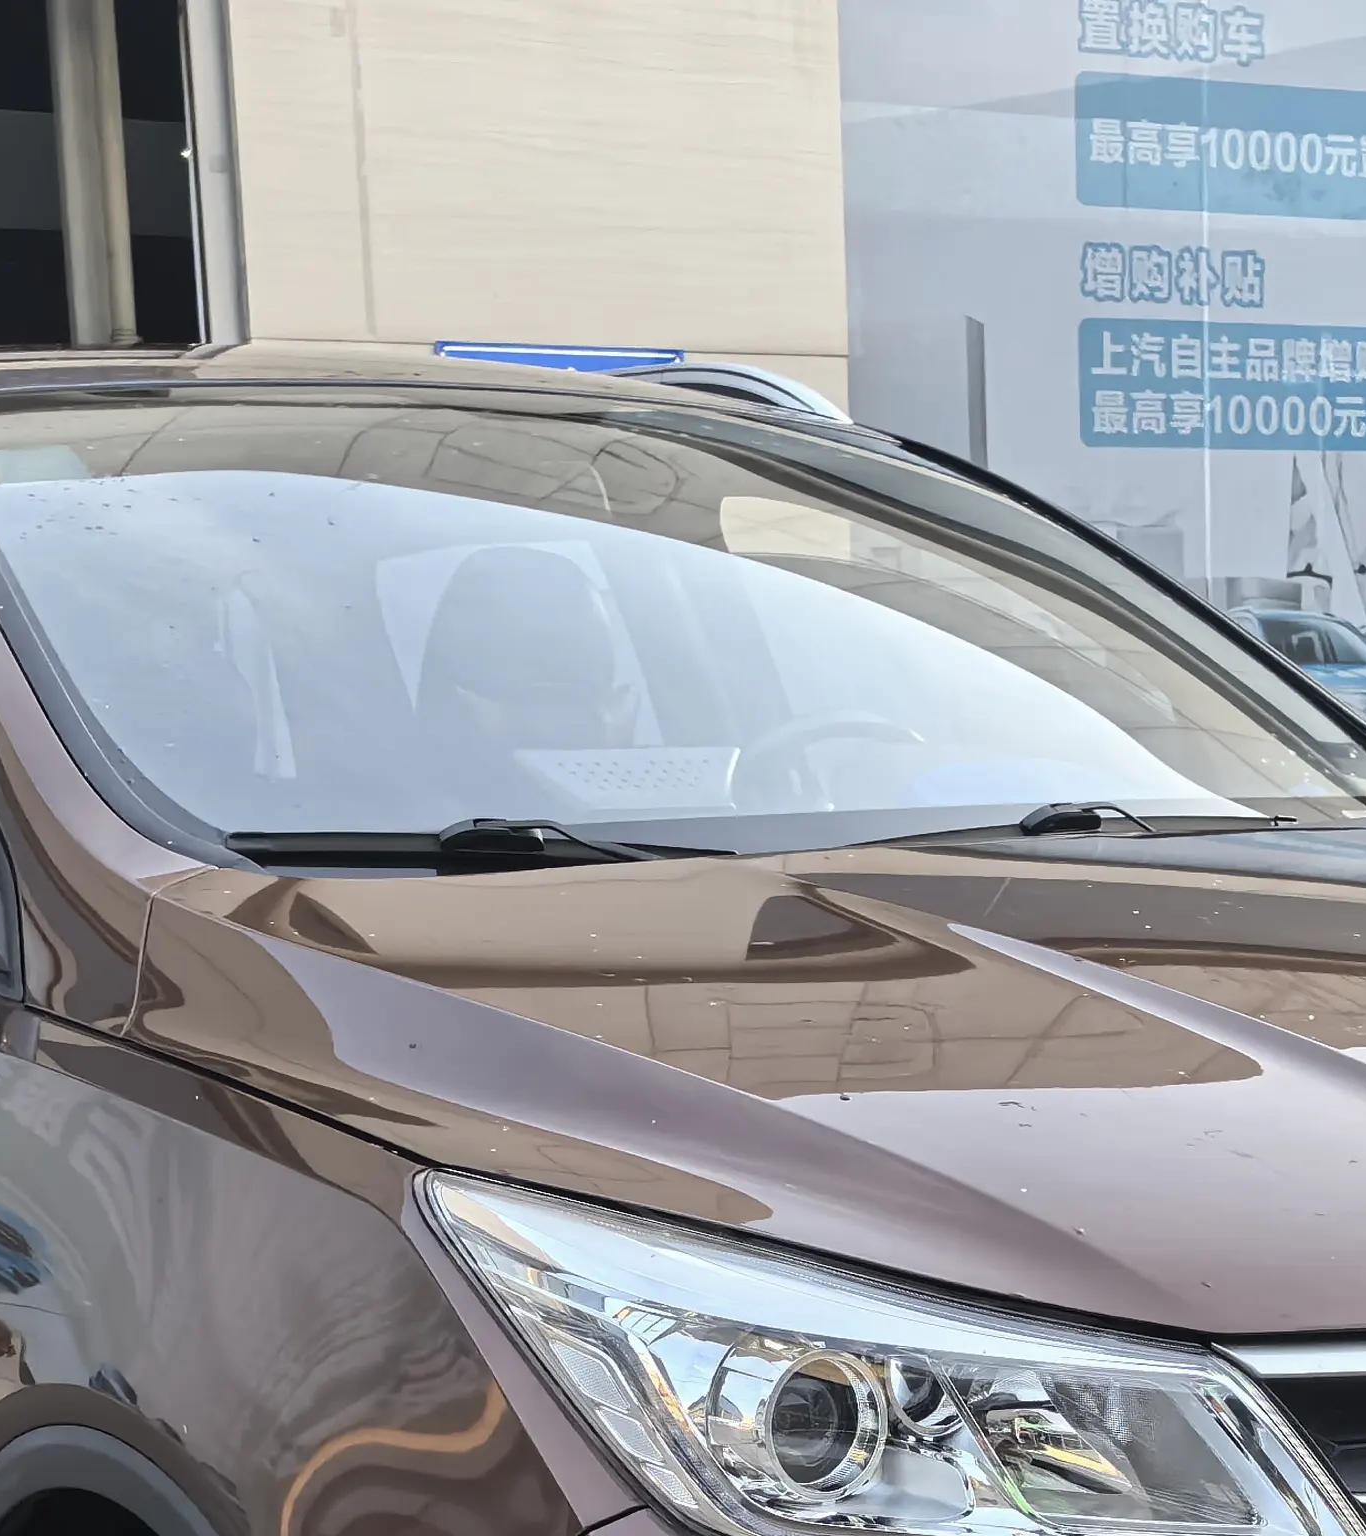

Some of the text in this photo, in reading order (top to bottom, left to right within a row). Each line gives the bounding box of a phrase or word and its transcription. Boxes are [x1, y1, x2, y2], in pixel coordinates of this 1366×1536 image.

[1079, 0, 1265, 66] 置换购车
[1080, 242, 1265, 308] 增购补贴
